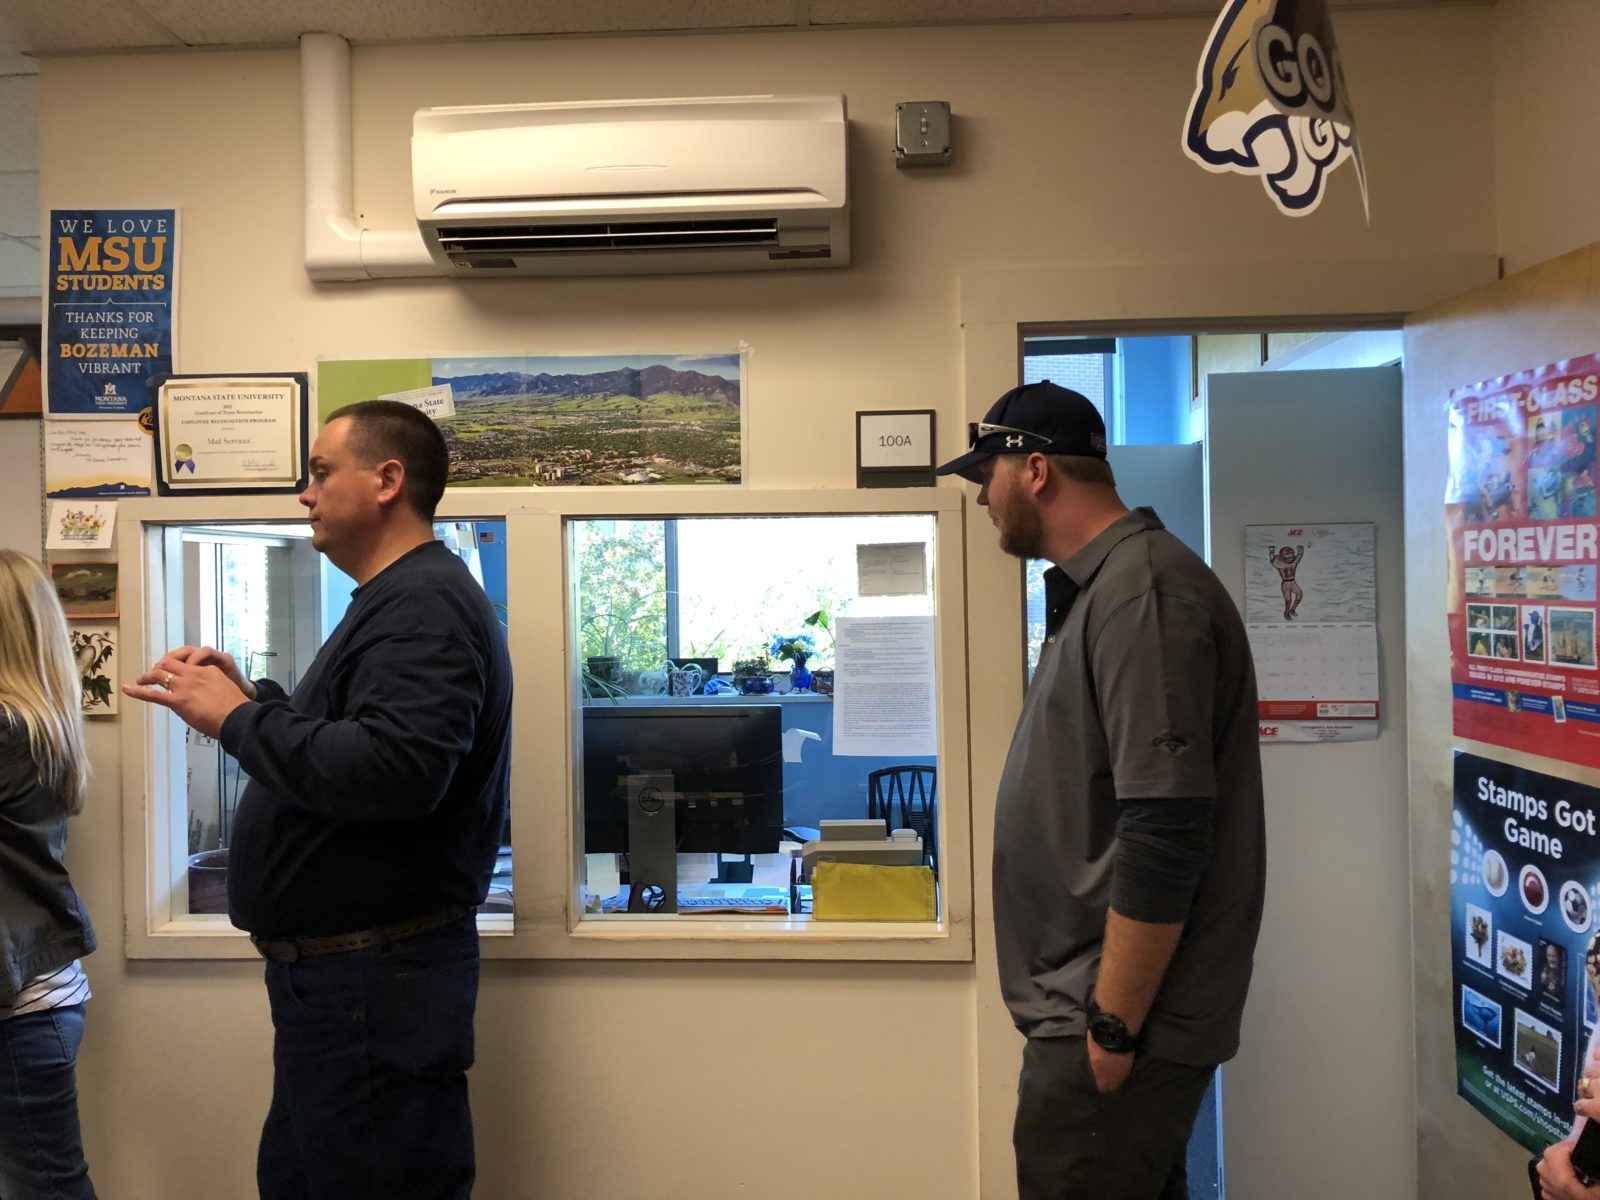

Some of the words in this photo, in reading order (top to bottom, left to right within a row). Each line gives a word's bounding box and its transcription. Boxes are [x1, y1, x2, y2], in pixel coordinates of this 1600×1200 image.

[60, 219, 93, 233] WE
[107, 219, 168, 233] LOVE
[57, 236, 167, 272] MSU
[56, 274, 165, 291] STUDENTS
[65, 312, 124, 323] THANKS
[128, 312, 154, 323] FOR
[81, 328, 138, 339] KEEPING
[60, 343, 159, 358] BOZEMAN
[78, 362, 141, 374] VIBRANT
[424, 398, 444, 407] State
[223, 437, 251, 445] Services
[879, 435, 912, 447] 100A
[1463, 524, 1598, 561] FOREVER
[1478, 776, 1548, 820] Stamps
[1555, 800, 1596, 836] Got
[1504, 817, 1563, 859] Game
[1482, 1065, 1495, 1080] Get
[1526, 1096, 1553, 1119] stamps
